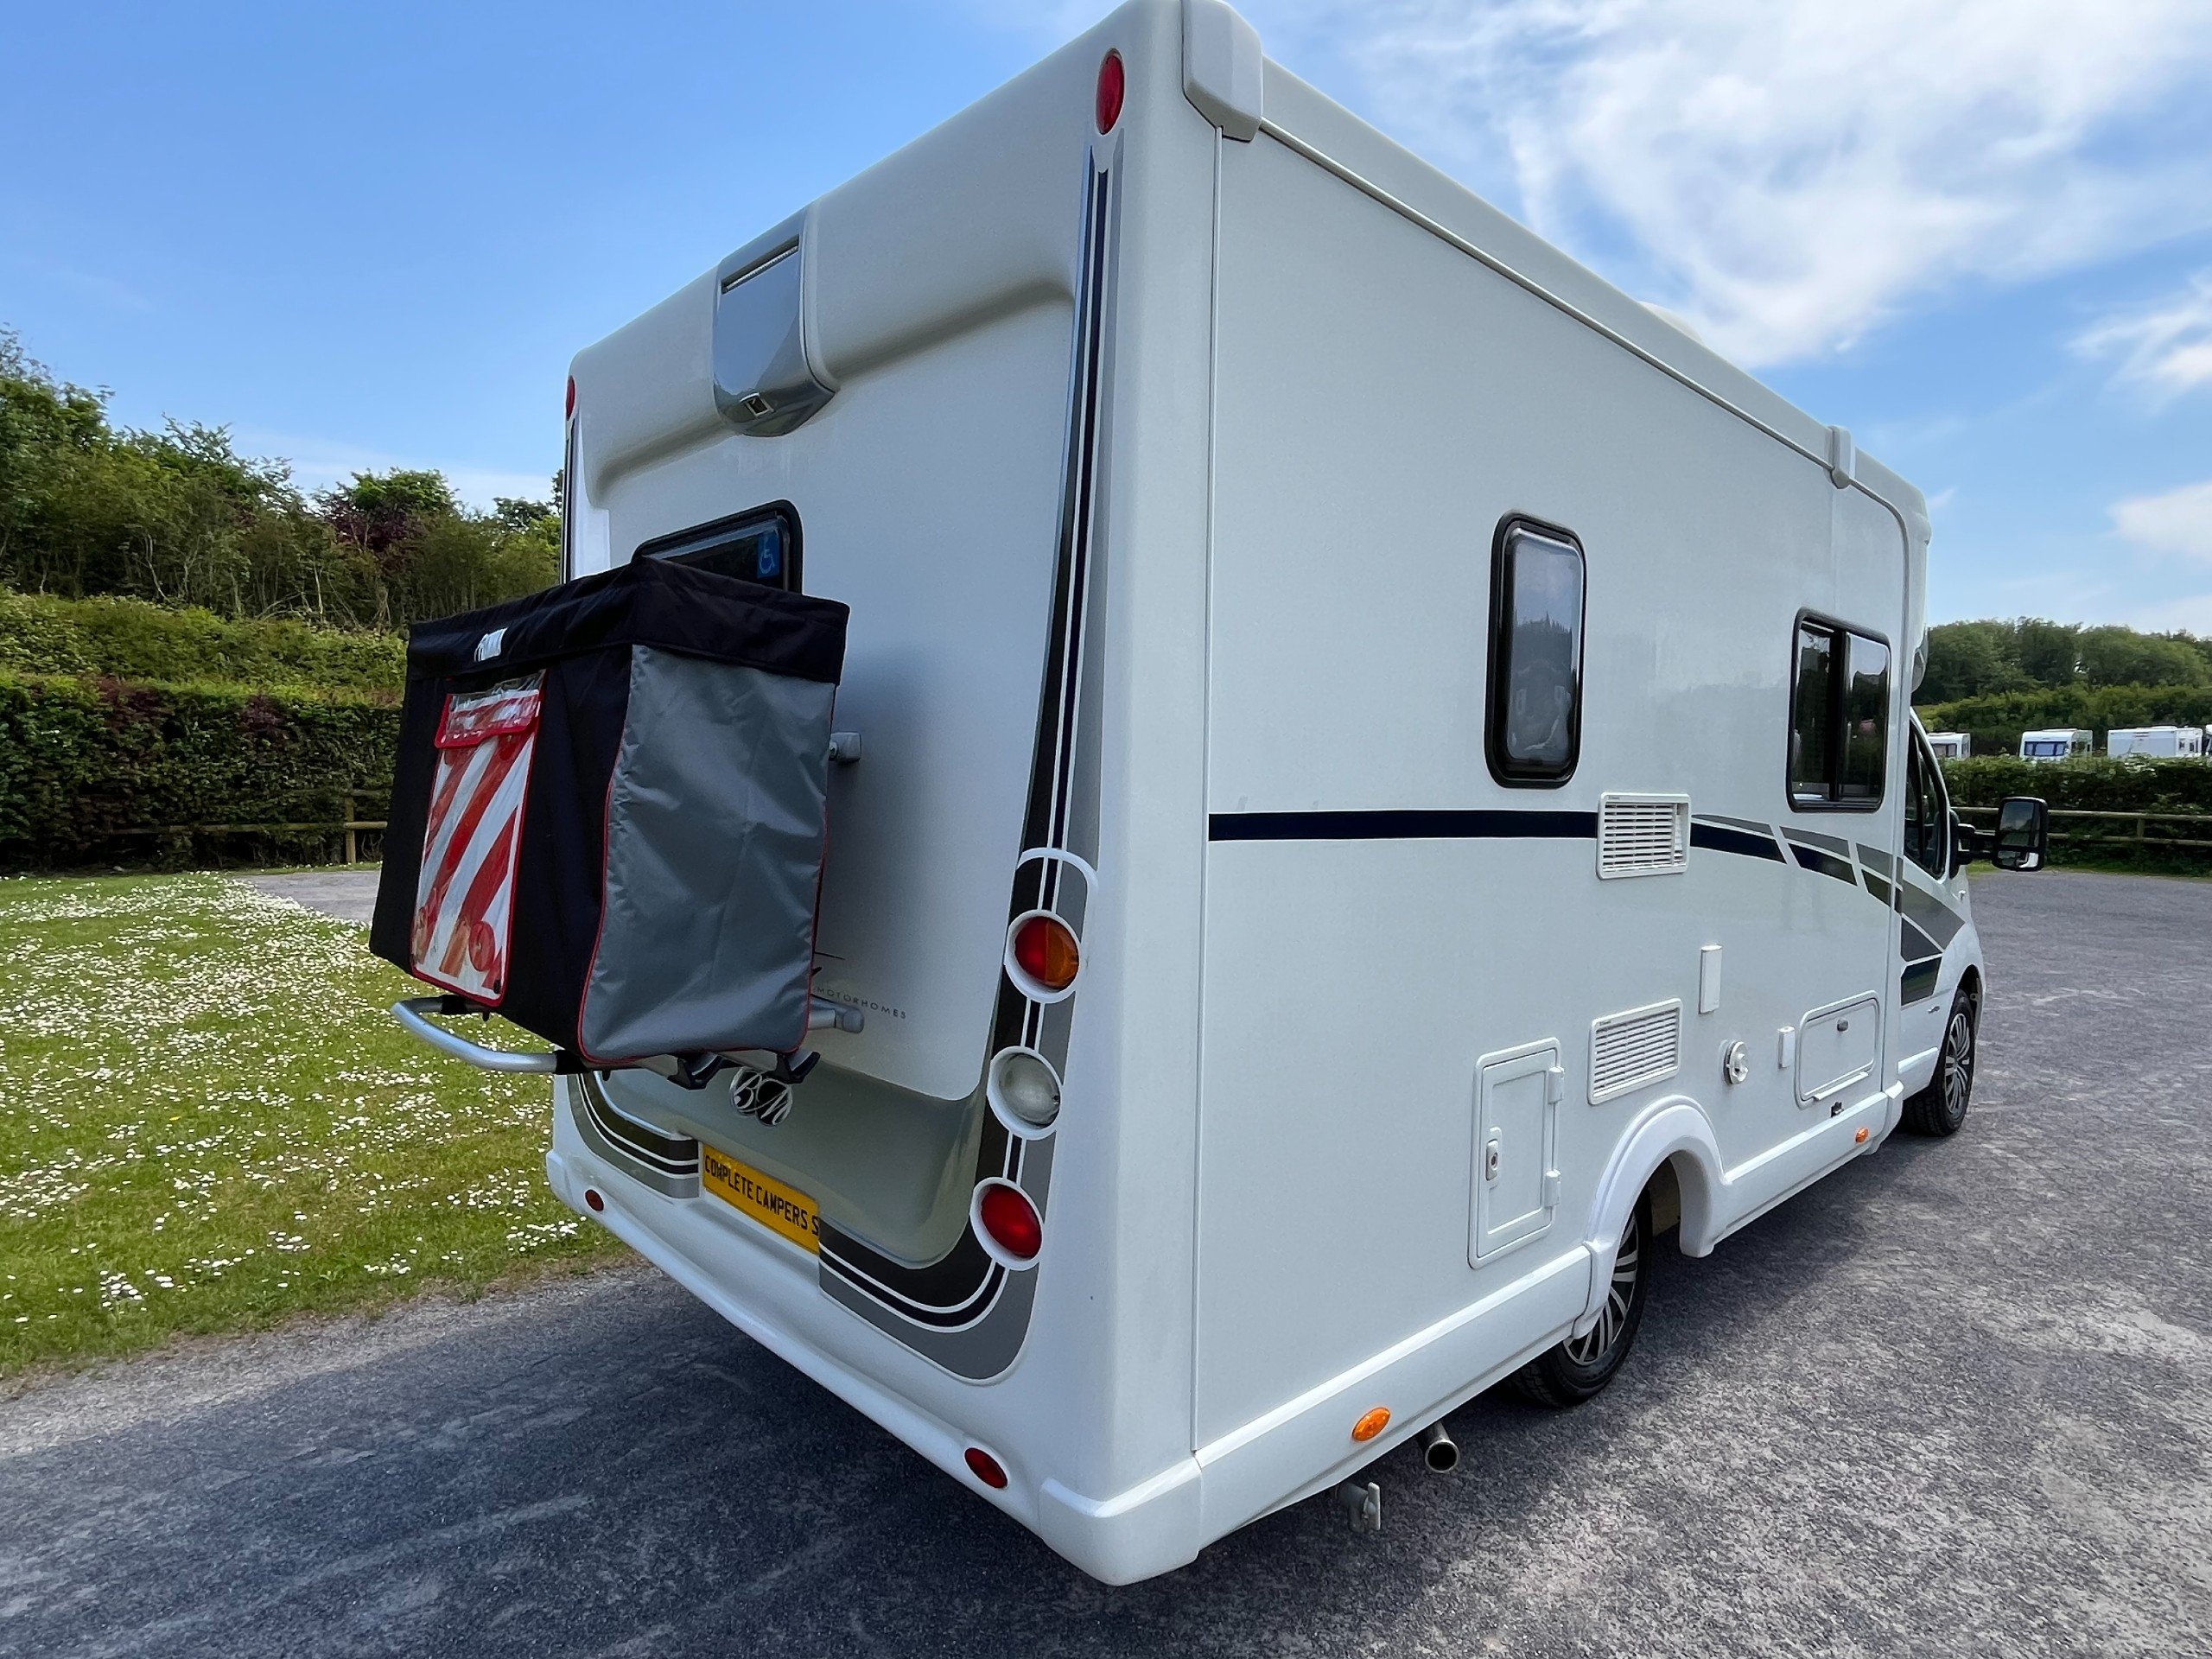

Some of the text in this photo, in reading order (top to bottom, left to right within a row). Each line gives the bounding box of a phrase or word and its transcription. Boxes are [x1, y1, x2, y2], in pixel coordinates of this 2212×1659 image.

[816, 986, 906, 1020] MOTORHOMES
[704, 1154, 753, 1201] COMPLETE
[756, 1185, 808, 1230] CAMPERS
